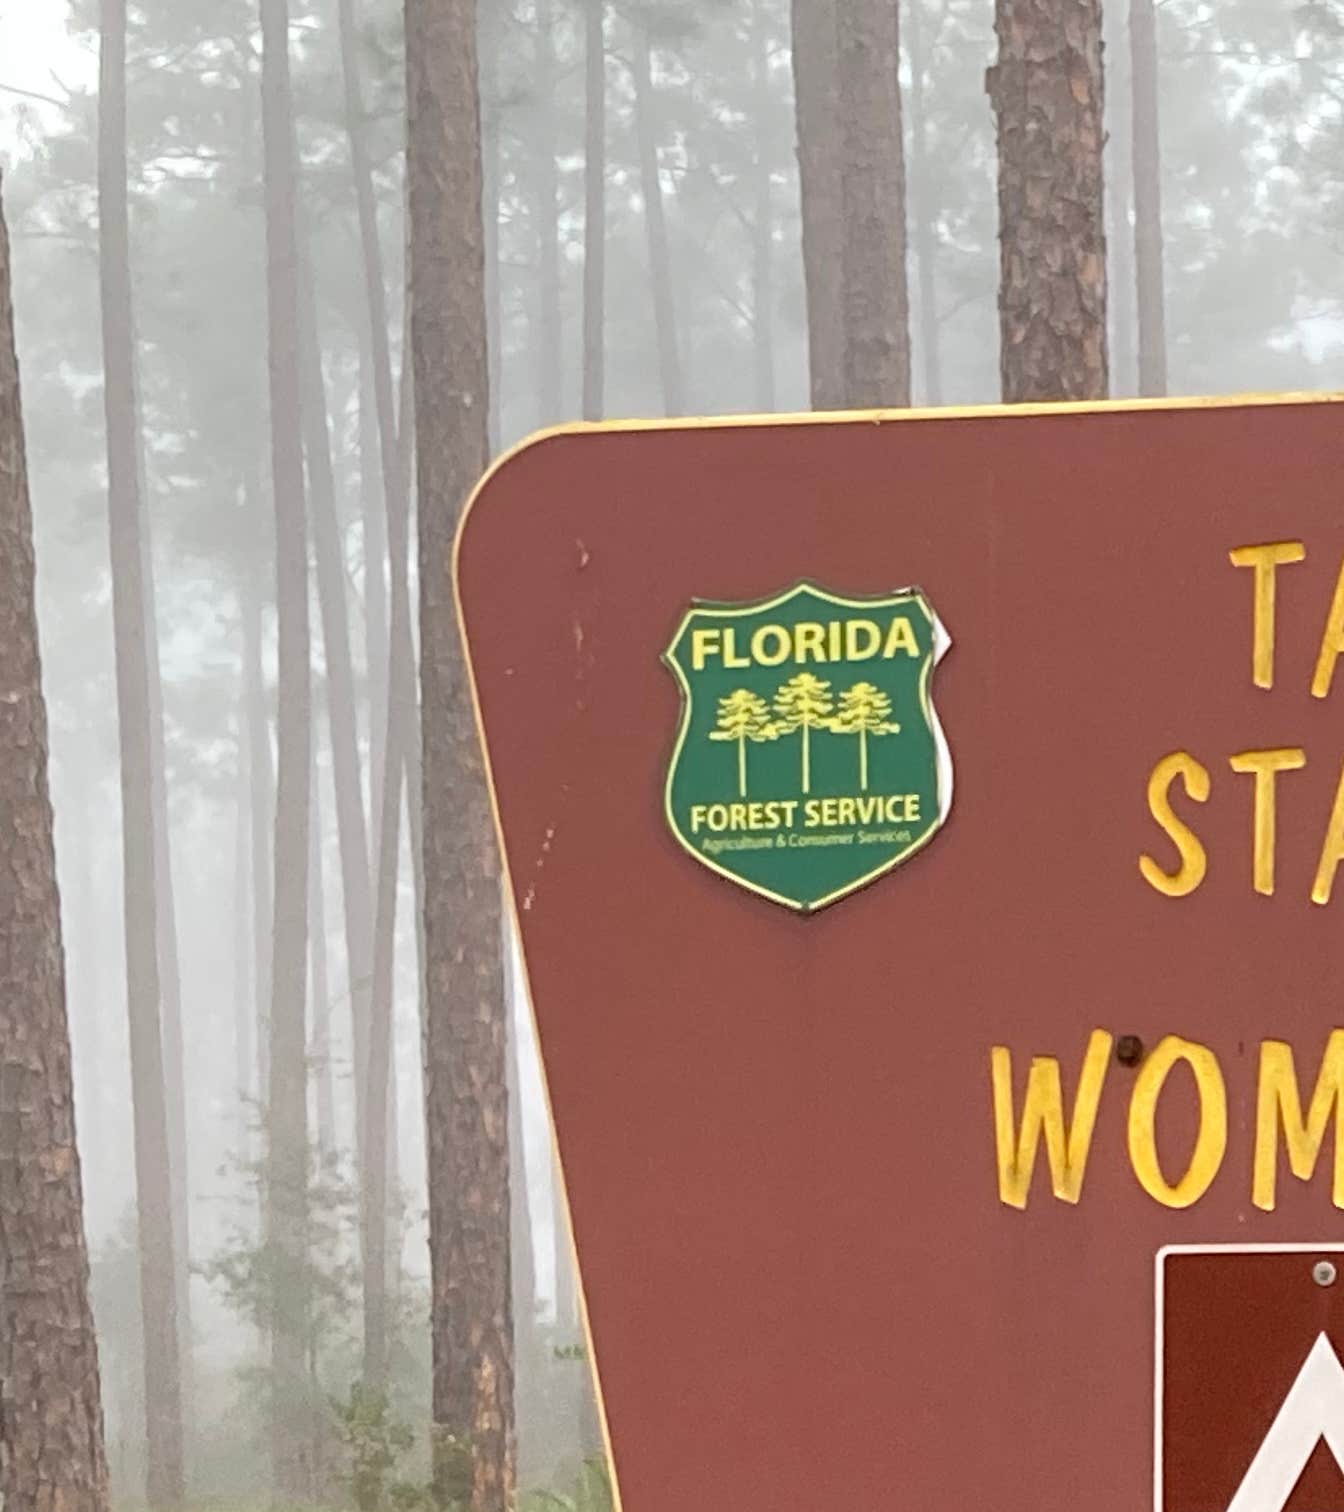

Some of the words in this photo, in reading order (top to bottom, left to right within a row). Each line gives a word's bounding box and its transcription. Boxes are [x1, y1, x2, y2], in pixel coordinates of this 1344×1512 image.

[692, 617, 919, 670] FLORIDA
[691, 801, 797, 833] FOREST
[804, 795, 920, 827] SERVICE
